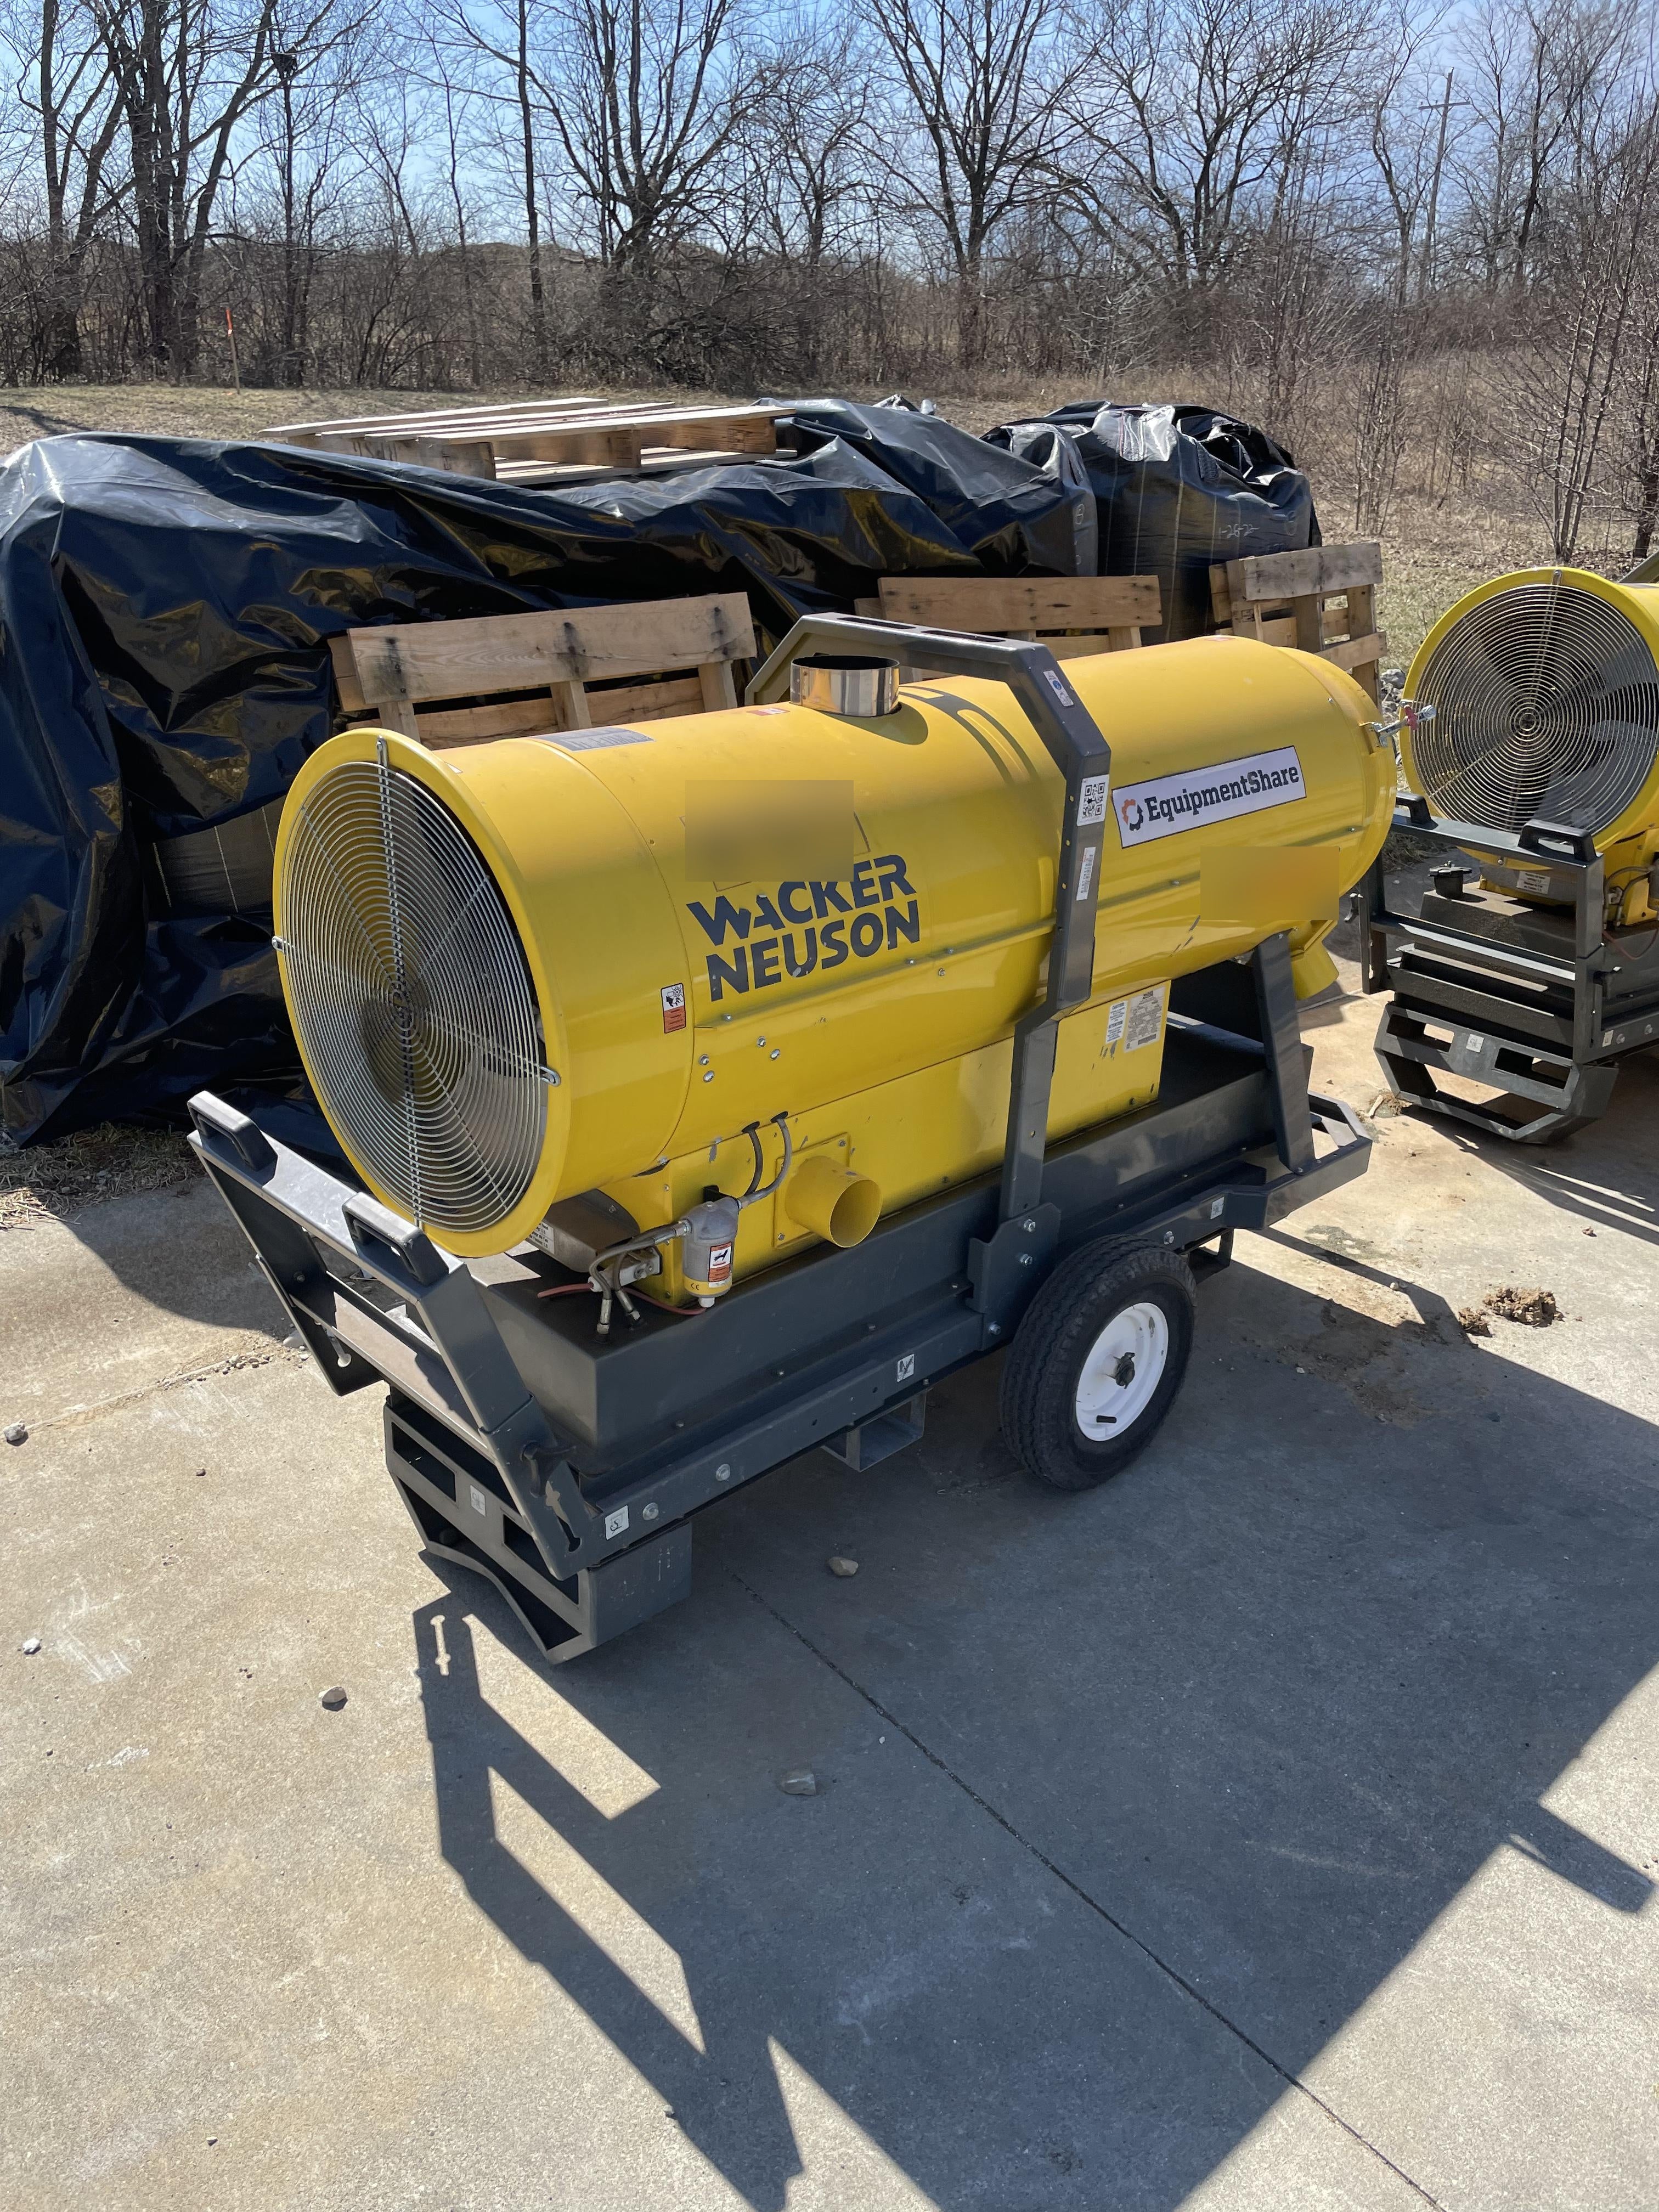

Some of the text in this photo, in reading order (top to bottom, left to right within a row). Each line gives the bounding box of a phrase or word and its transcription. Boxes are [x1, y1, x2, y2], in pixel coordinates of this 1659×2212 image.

[1144, 766, 1300, 822] EquipmentShare
[686, 854, 917, 946] WACKER
[706, 899, 920, 1002] NEUSON
